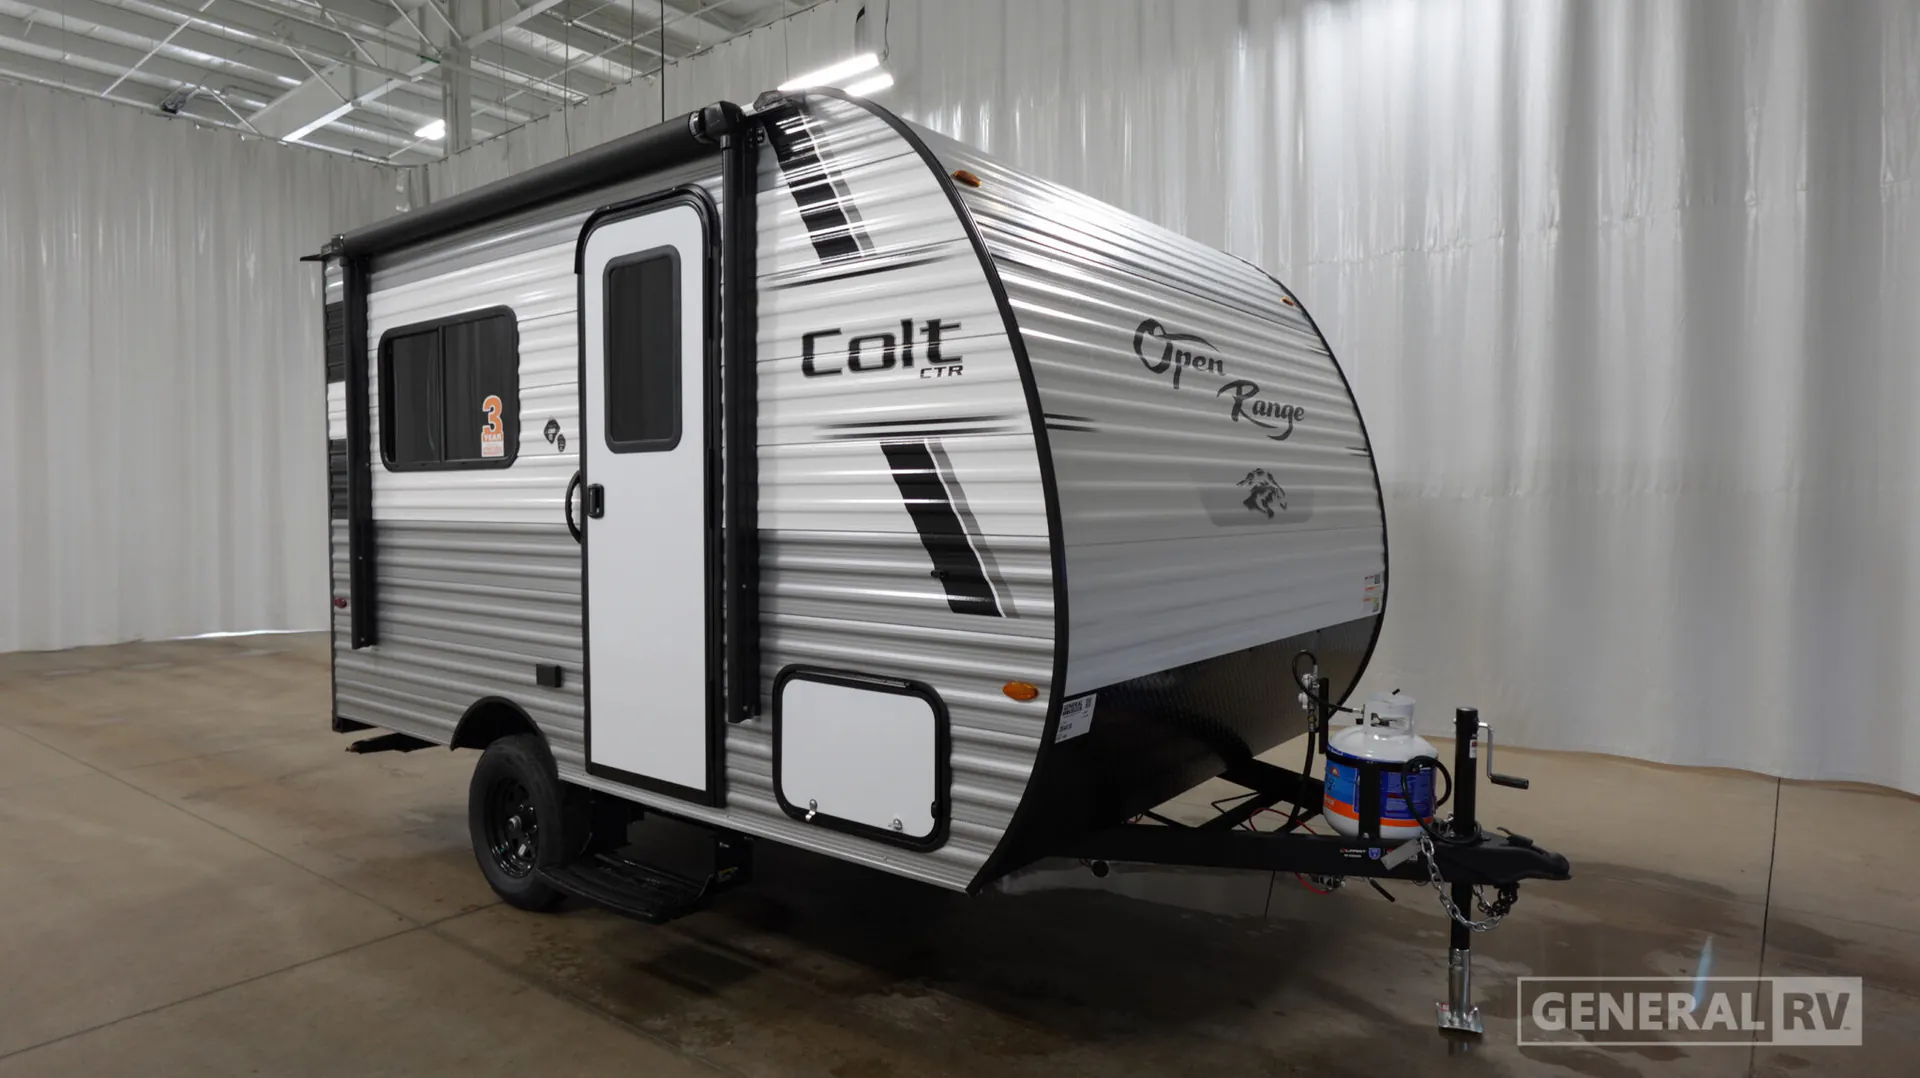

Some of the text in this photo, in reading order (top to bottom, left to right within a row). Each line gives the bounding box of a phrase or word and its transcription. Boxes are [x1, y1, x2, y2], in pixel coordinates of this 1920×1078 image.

[801, 318, 963, 377] Colt
[919, 365, 963, 379] CTR
[1133, 318, 1226, 389] Open
[482, 395, 503, 435] 3
[1216, 379, 1305, 441] Range
